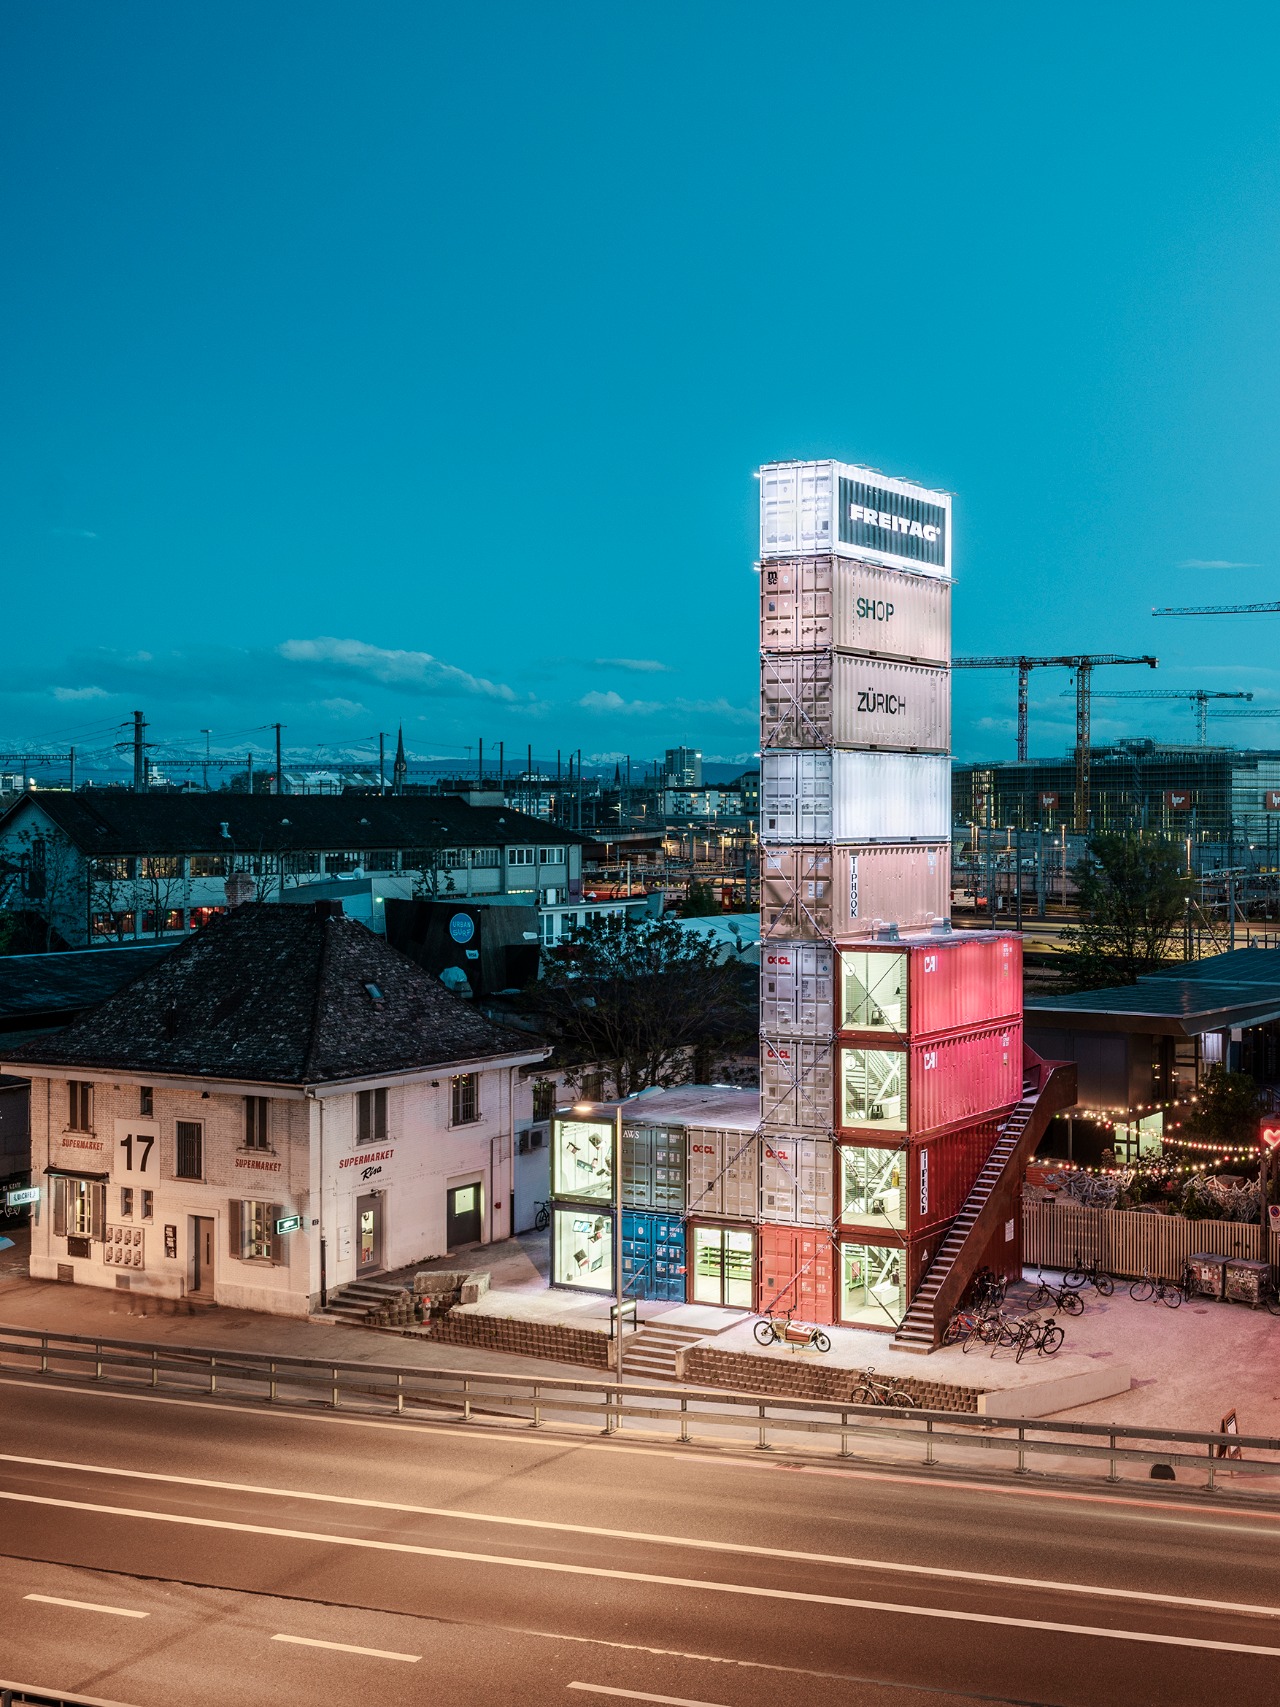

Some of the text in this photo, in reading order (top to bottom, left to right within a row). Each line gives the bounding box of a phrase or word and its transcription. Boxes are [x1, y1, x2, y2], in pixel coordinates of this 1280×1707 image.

[850, 503, 937, 542] FREITAG
[856, 597, 895, 622] SHOP
[857, 687, 906, 715] ZÜRICH
[850, 856, 858, 918] TIPHOOK
[452, 929, 471, 937] SURF
[62, 1138, 104, 1151] SUPERMARKET
[623, 1131, 640, 1139] AWS
[120, 1134, 155, 1172] 17
[339, 1149, 395, 1169] SUPERMARKET
[235, 1158, 282, 1172] SUPERMARKET
[361, 1165, 382, 1181] Risa
